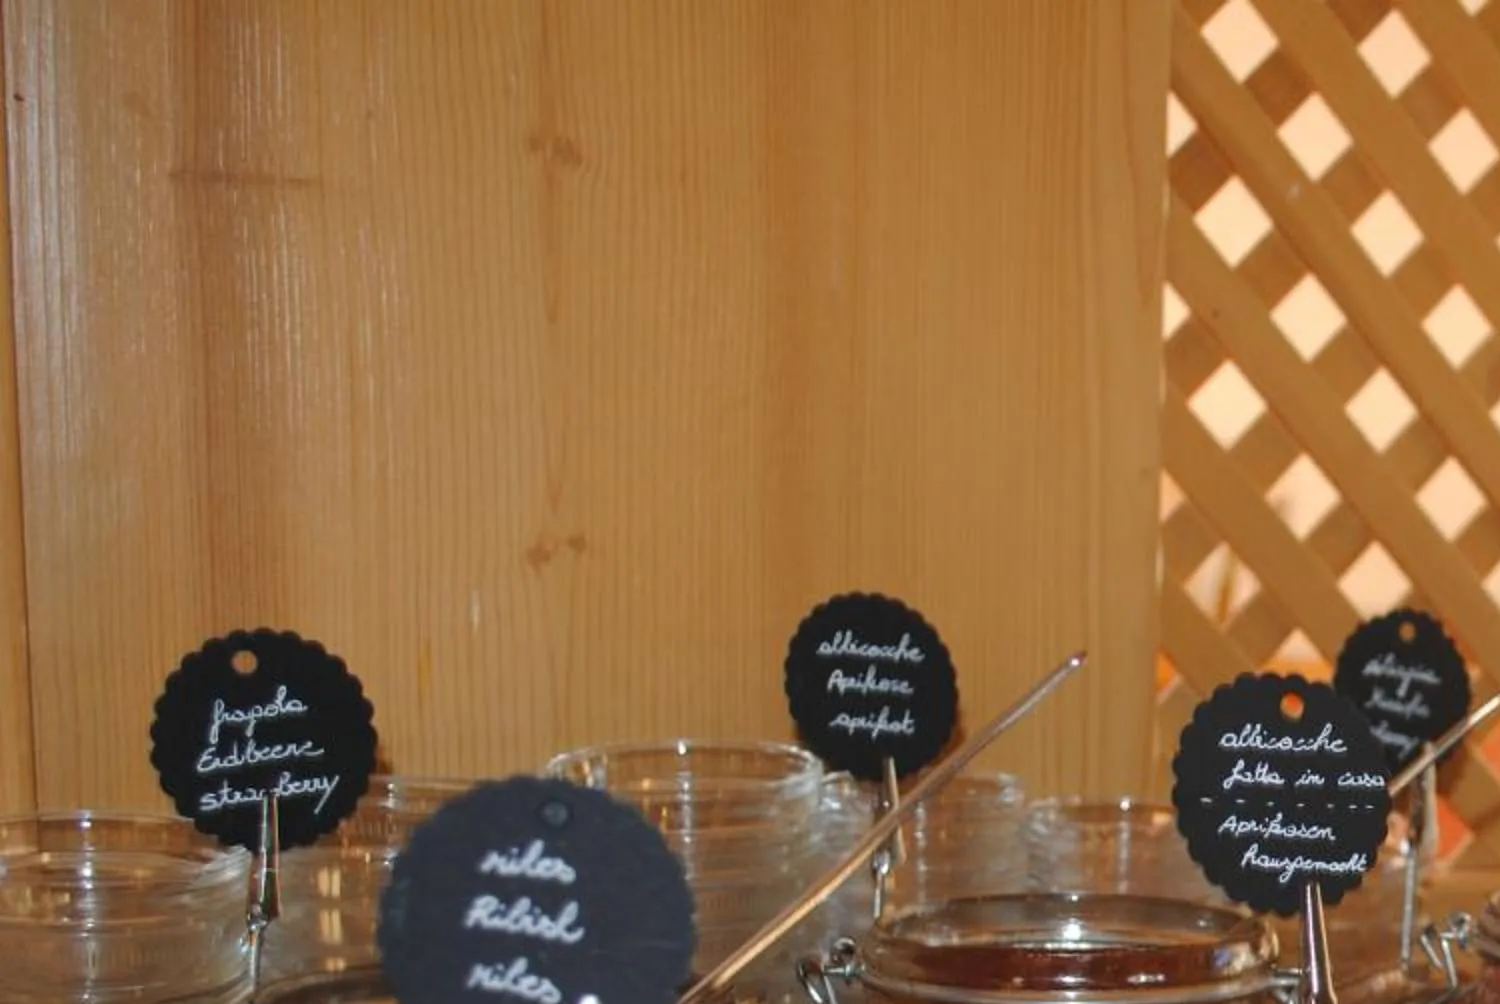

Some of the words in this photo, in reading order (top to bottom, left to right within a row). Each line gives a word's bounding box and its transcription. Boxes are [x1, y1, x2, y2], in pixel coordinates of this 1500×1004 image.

[196, 738, 325, 773] Erdbeere
[1295, 769, 1325, 786] in
[1337, 771, 1386, 788] casa
[1217, 812, 1337, 840] Aprikosen
